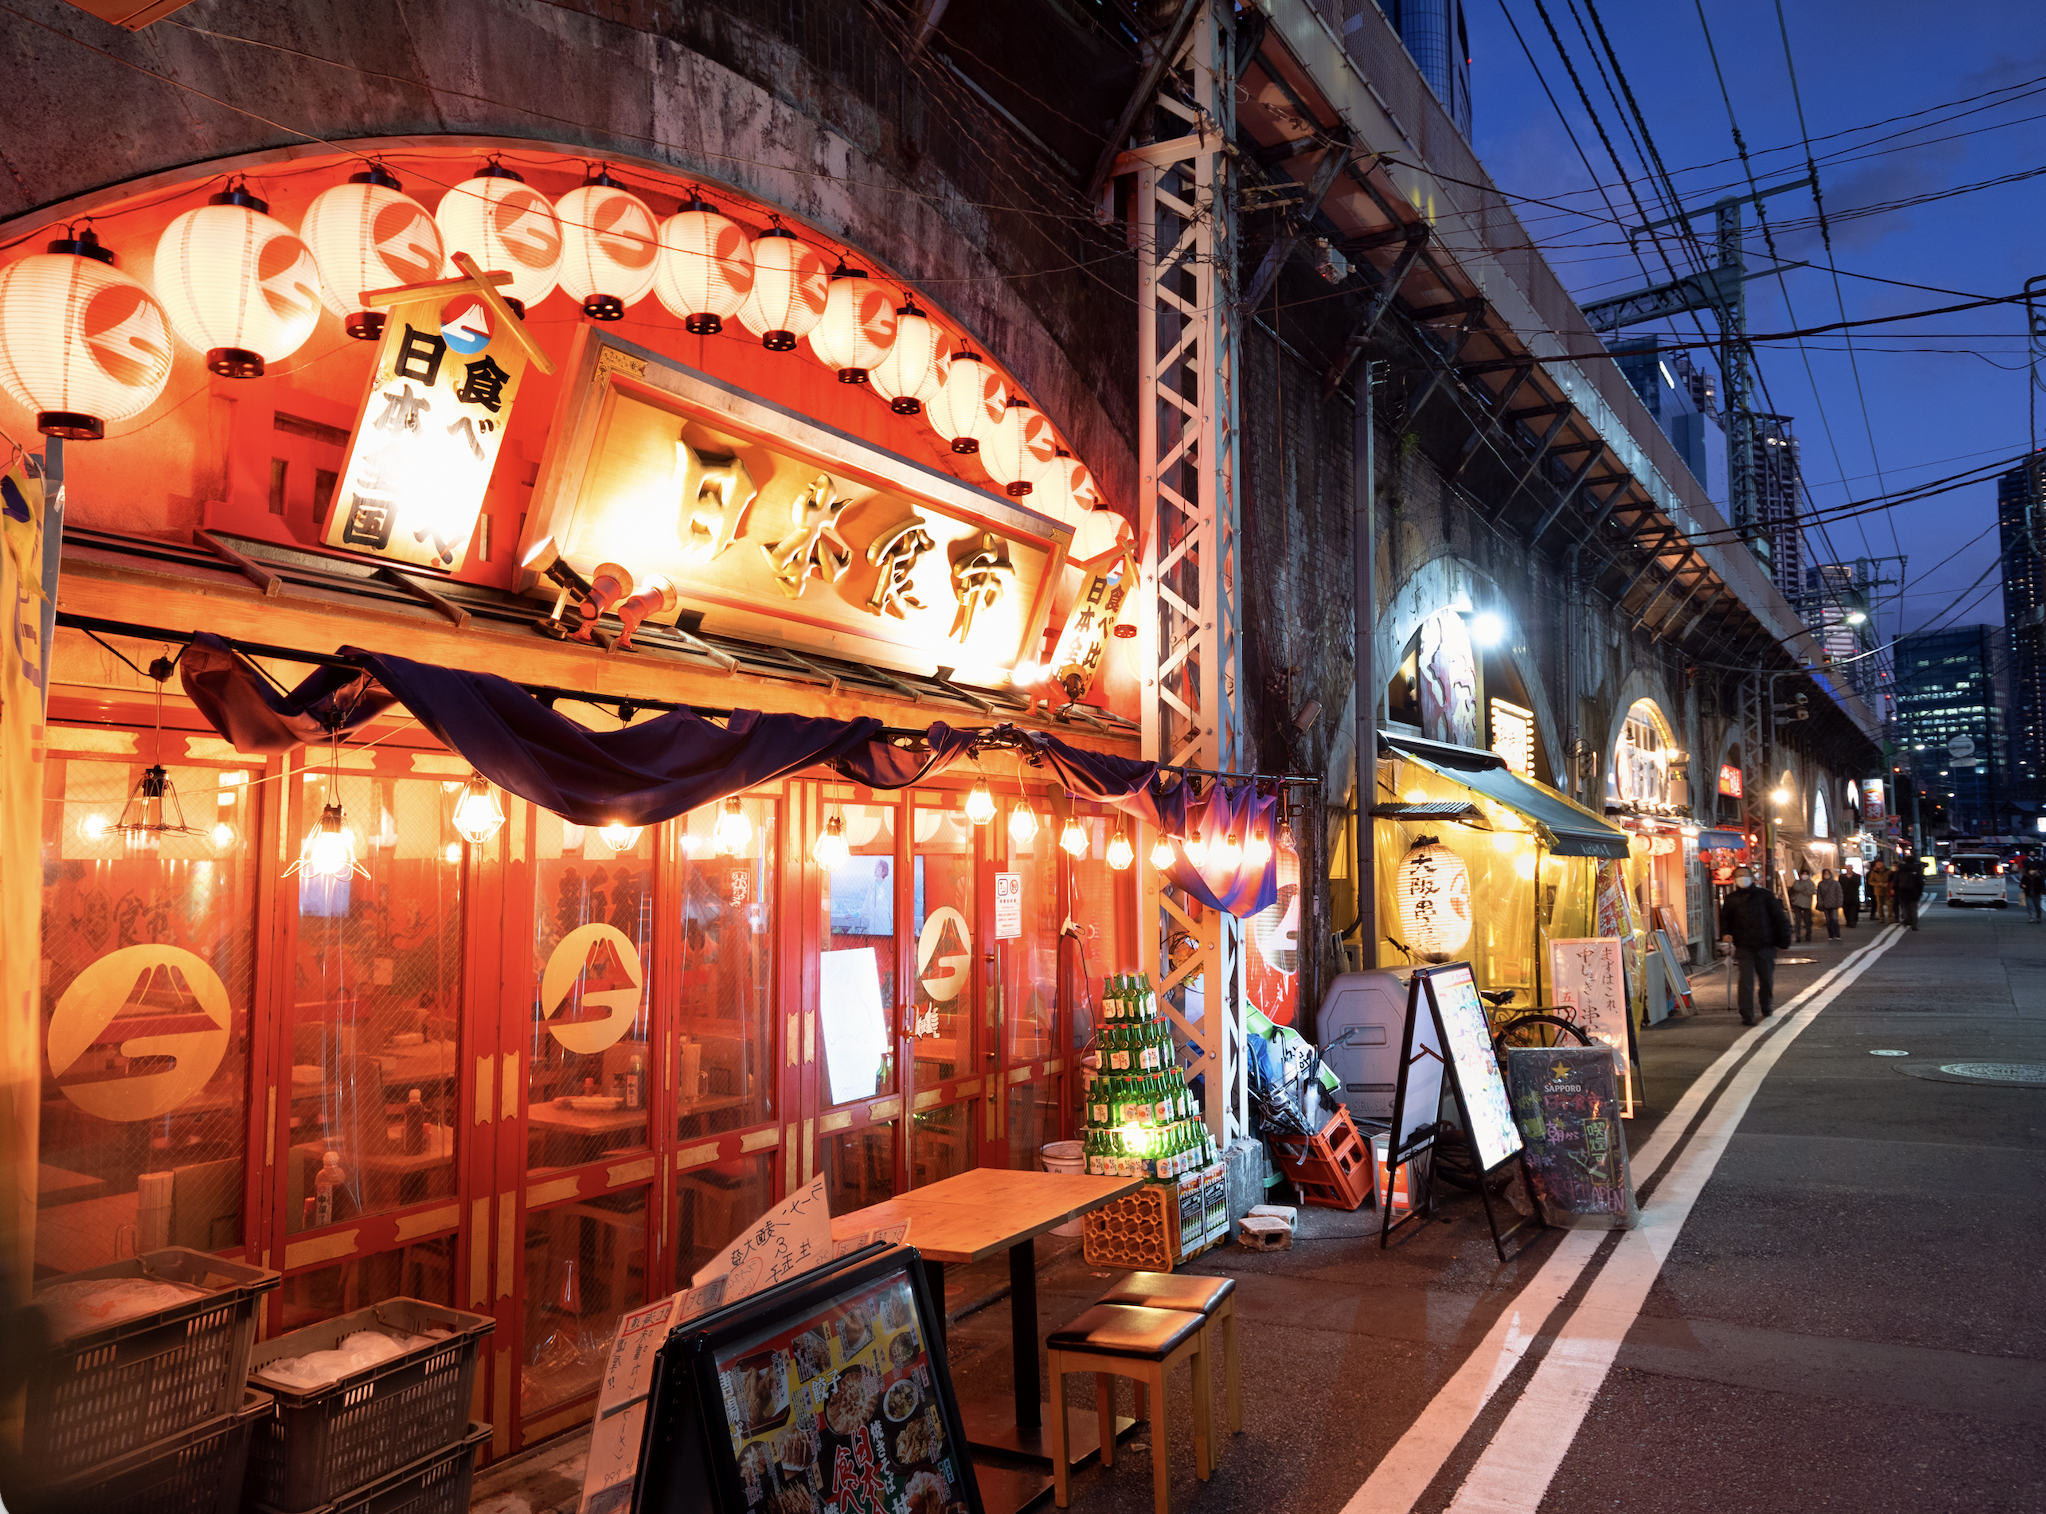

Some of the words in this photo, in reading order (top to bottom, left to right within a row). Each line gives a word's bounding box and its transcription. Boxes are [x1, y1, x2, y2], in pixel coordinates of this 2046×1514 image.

[1544, 1084, 1582, 1093] SAPPORO
[1546, 1120, 1580, 1146] 朝から
[1591, 1185, 1625, 1212] OPEN
[811, 1368, 841, 1405] 餃子
[869, 1419, 898, 1496] 焼きそば
